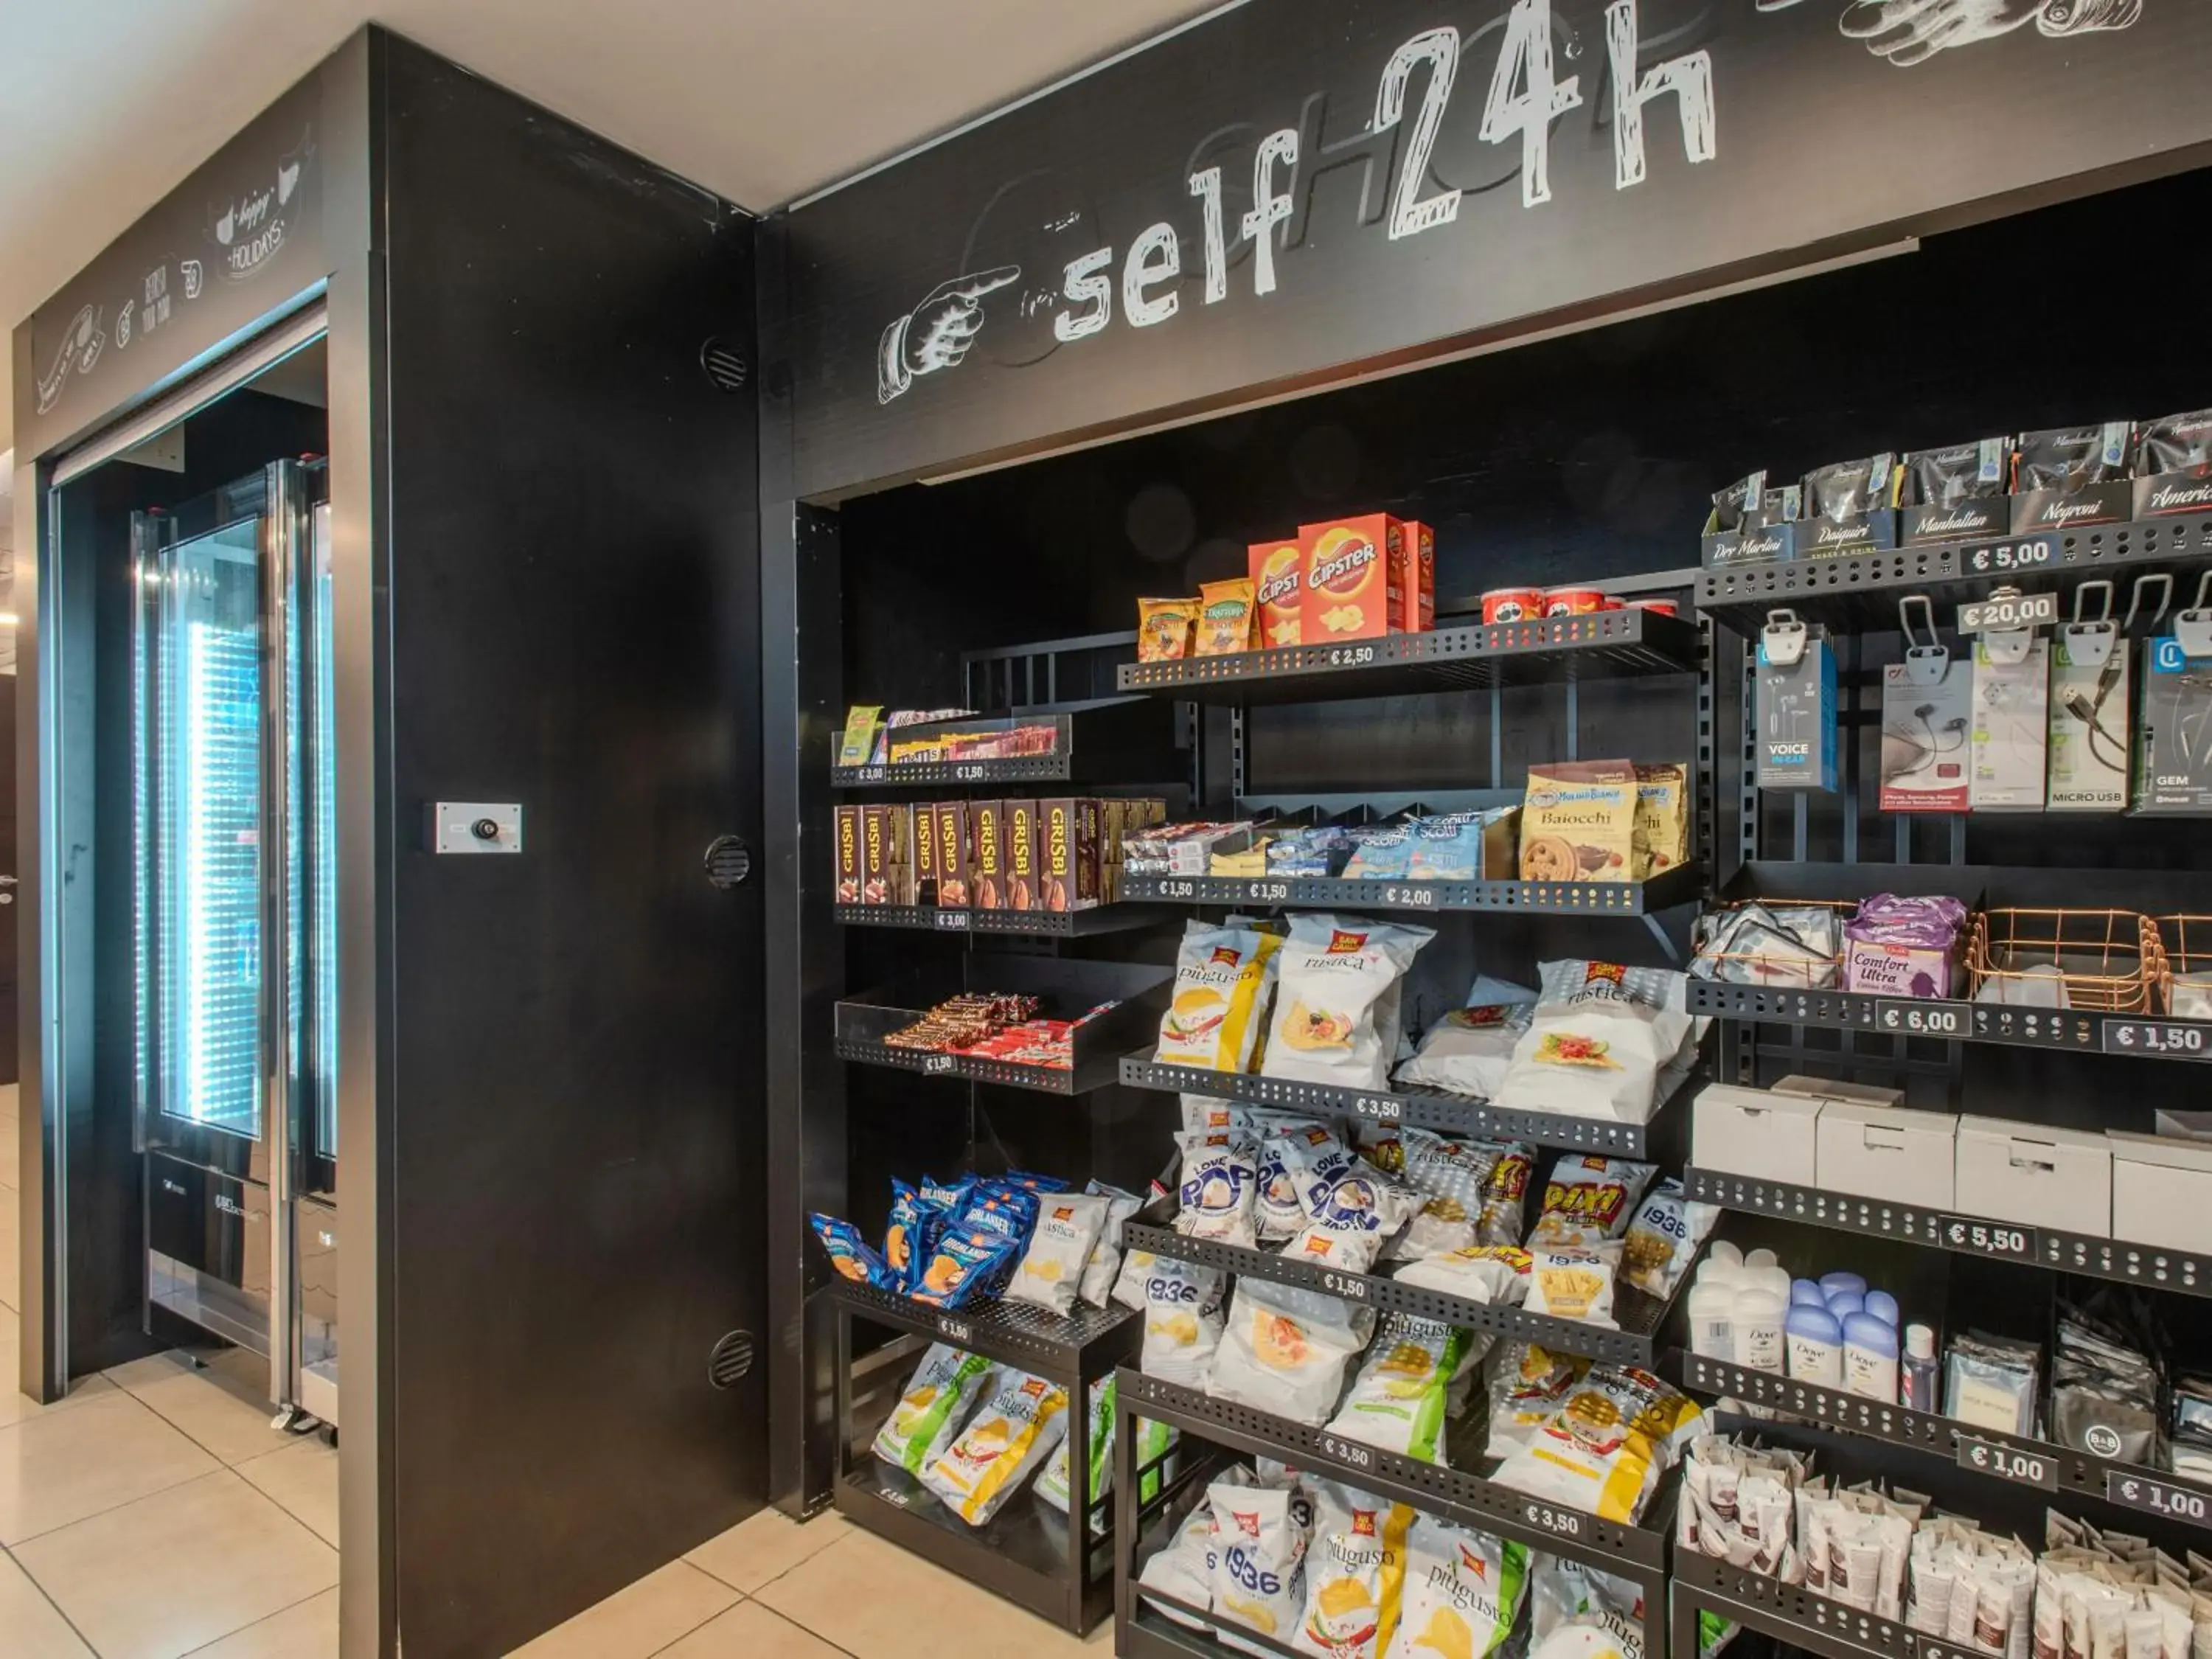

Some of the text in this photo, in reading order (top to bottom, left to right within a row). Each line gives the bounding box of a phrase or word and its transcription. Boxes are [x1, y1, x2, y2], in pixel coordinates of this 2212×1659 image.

[1054, 0, 1717, 341] self 24h
[238, 193, 269, 230] happy
[232, 219, 282, 268] HOLIDAYS
[2042, 500, 2103, 528] Negroni
[1713, 537, 1783, 559] Dry Martini
[1972, 542, 2049, 569] € 5,00
[1309, 542, 1377, 590] CIPSTER
[1964, 599, 2050, 625] € 20,00
[1332, 647, 1373, 665] € 2,50
[1769, 743, 1809, 755] VOICE
[2157, 776, 2188, 785] GEM
[2053, 793, 2122, 802] MICRO USB
[1542, 812, 1612, 824] Baiocchi
[1159, 882, 1192, 897] € 1,50
[1251, 884, 1287, 900] € 1,50
[1386, 888, 1431, 906] € 2,00
[1854, 952, 1909, 971] Comfort
[1861, 967, 1897, 984] Ultra
[1885, 1009, 1956, 1032] € 6,00
[2116, 1026, 2202, 1051] € 1,50
[1357, 1099, 1400, 1119] € 3,50
[1193, 1155, 1228, 1174] LOVE
[1311, 1152, 1343, 1176] LOVE
[1643, 1206, 1687, 1239] 1936
[1947, 1223, 2025, 1253] € 5,50
[1324, 1274, 1364, 1298] € 1,50
[1325, 1439, 1368, 1466] € 3,50
[1971, 1446, 2043, 1481] € 1,00
[2121, 1480, 2205, 1519] € 1,00
[1526, 1506, 1579, 1535] € 3,50
[1225, 1546, 1281, 1595] 1936
